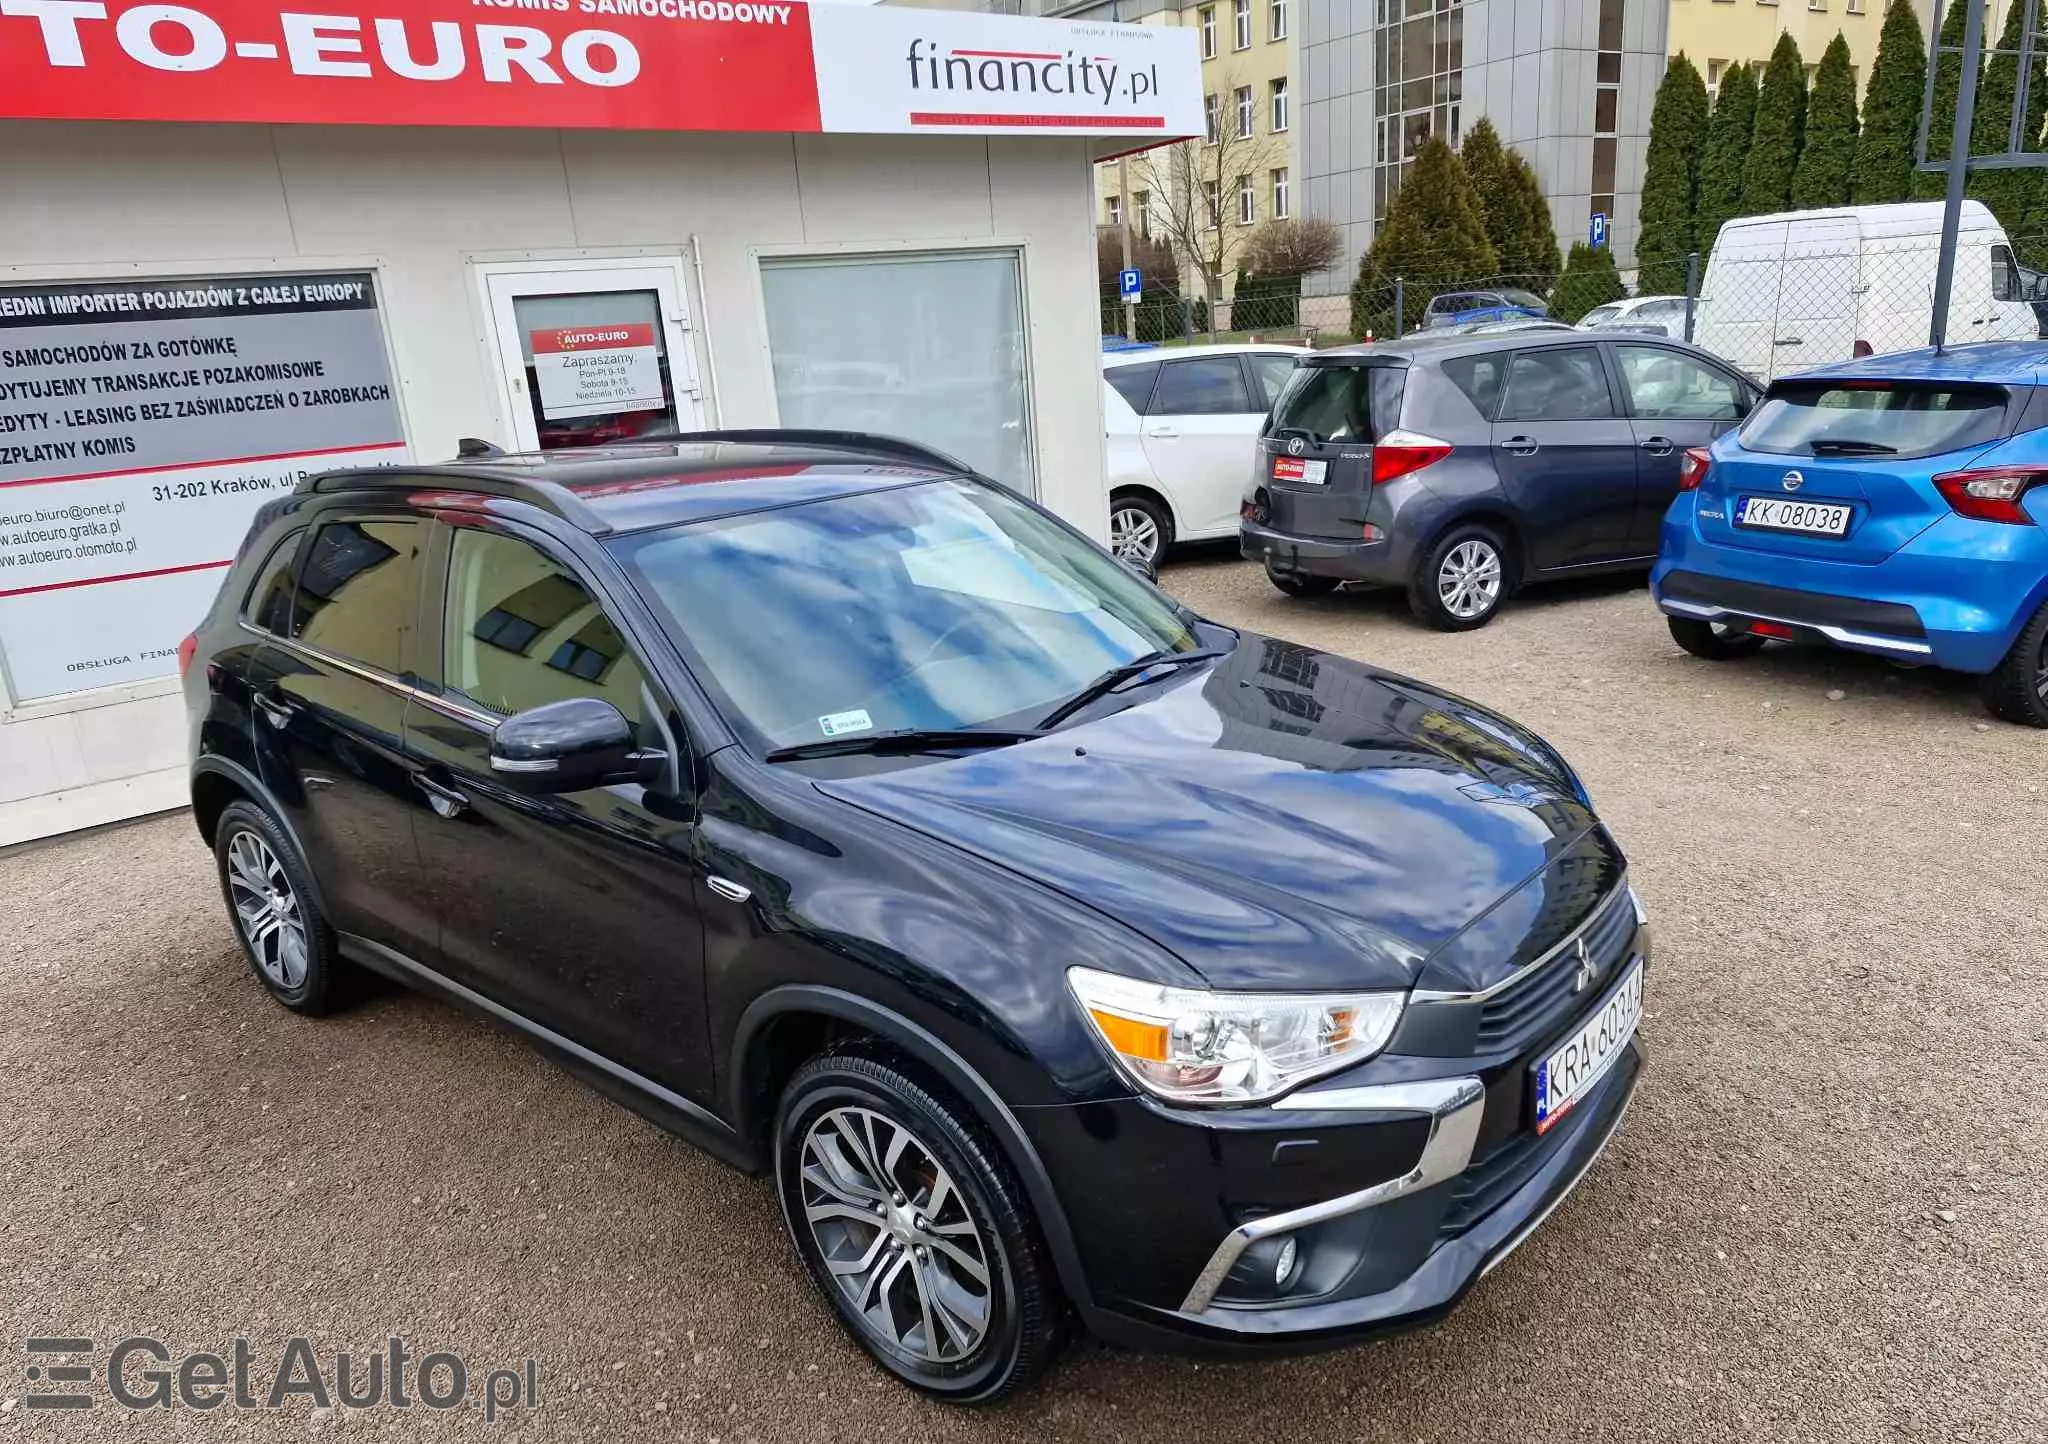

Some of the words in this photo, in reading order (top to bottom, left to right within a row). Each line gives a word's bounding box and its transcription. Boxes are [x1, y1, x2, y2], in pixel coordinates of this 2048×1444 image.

[579, 0, 791, 25] SAMOCHODOWY
[0, 0, 641, 88] TO-EURO
[907, 38, 1158, 105] financity.pl
[1594, 217, 1602, 240] P
[1125, 272, 1136, 291] P
[50, 293, 141, 314] IMPORTER
[142, 284, 233, 310] POJAZDÓW
[236, 288, 249, 305] Z
[251, 285, 300, 305] CAŁEJ
[303, 283, 363, 302] EUROPY
[2, 341, 127, 368] SAMOCHODÓW
[131, 341, 154, 360] ZA
[158, 336, 238, 358] GOTÓWKĘ
[564, 331, 629, 344] AUTO-EURO
[92, 370, 201, 394] TRANSAKCJE
[204, 361, 325, 386] POZAKOMISOWE
[64, 405, 137, 427] LEASING
[140, 402, 172, 421] BEZ
[174, 390, 285, 418] ZAŚWIADCZEŃ
[289, 391, 299, 408] O
[303, 384, 391, 407] ZAROBKACH
[0, 442, 76, 465] ZPŁATNY
[82, 436, 136, 457] KOMIS
[153, 483, 208, 502] 31-202
[211, 474, 276, 496] Kraków,
[1749, 501, 1776, 523] KK
[1779, 504, 1843, 530] 08038
[66, 655, 132, 672] OBSŁUGA
[1550, 1033, 1592, 1106] KRA
